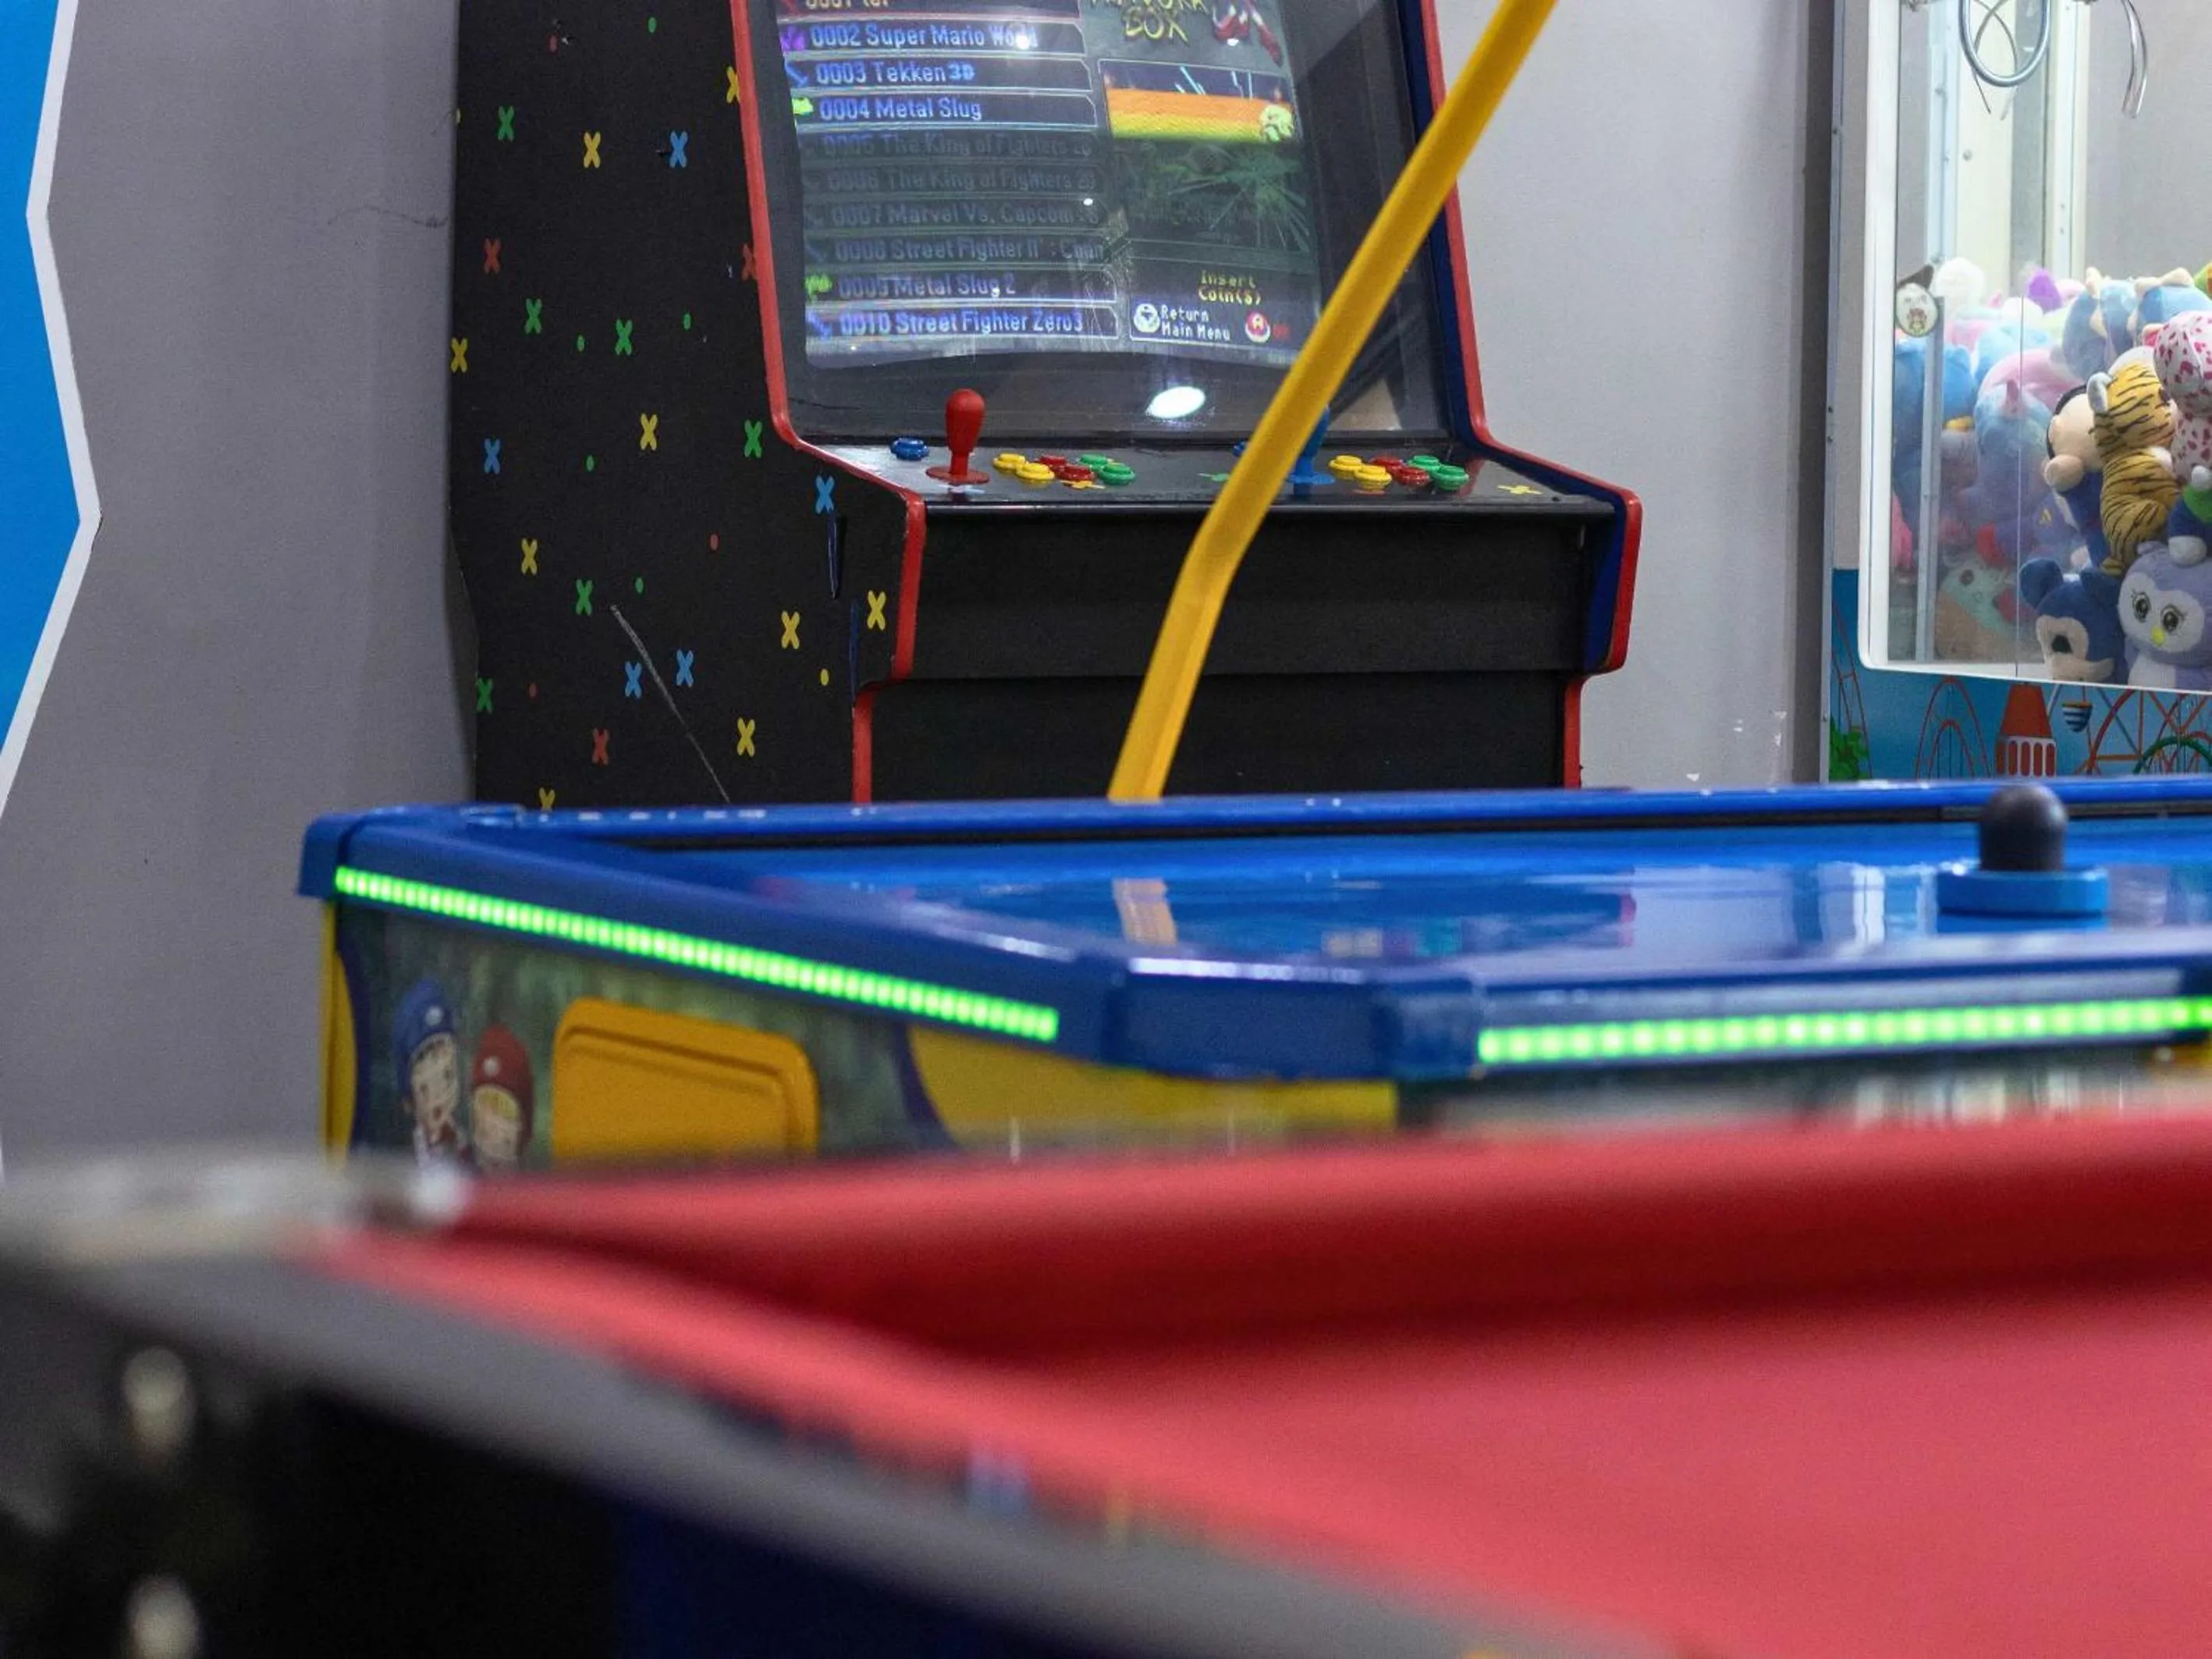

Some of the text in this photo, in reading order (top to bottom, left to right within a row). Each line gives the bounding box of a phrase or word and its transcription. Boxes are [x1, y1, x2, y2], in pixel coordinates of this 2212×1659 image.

[811, 24, 861, 47] 0002
[865, 23, 926, 48] Super
[930, 24, 984, 45] Mario
[816, 62, 866, 83] 0003
[872, 61, 946, 83] Tekken
[820, 97, 982, 121] 0004 Metal Slug
[890, 238, 954, 260] Street
[957, 236, 1022, 261] Fighter
[893, 273, 953, 297] Metal
[956, 272, 1000, 298] Slug
[1003, 272, 1016, 295] 2
[840, 309, 891, 336] 0010
[896, 310, 958, 334] Street
[960, 307, 1028, 336] Fighter
[1161, 304, 1209, 323] Return
[1162, 321, 1230, 341] Main Menu
